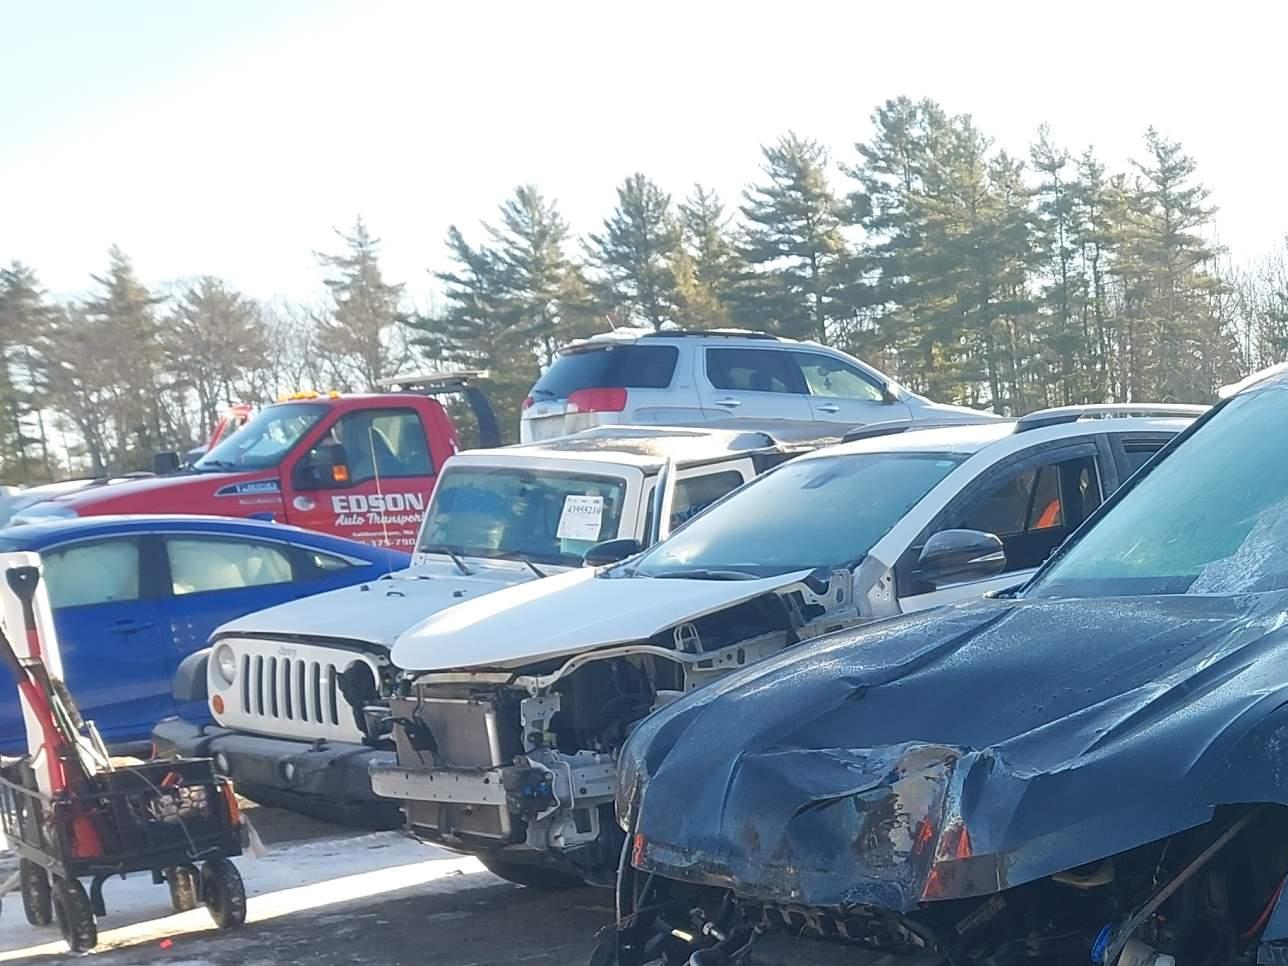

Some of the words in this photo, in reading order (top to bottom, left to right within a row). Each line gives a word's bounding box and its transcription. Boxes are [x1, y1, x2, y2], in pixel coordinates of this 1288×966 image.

[331, 492, 425, 514] EDSON
[334, 512, 366, 526] Auto
[366, 511, 426, 526] Transport
